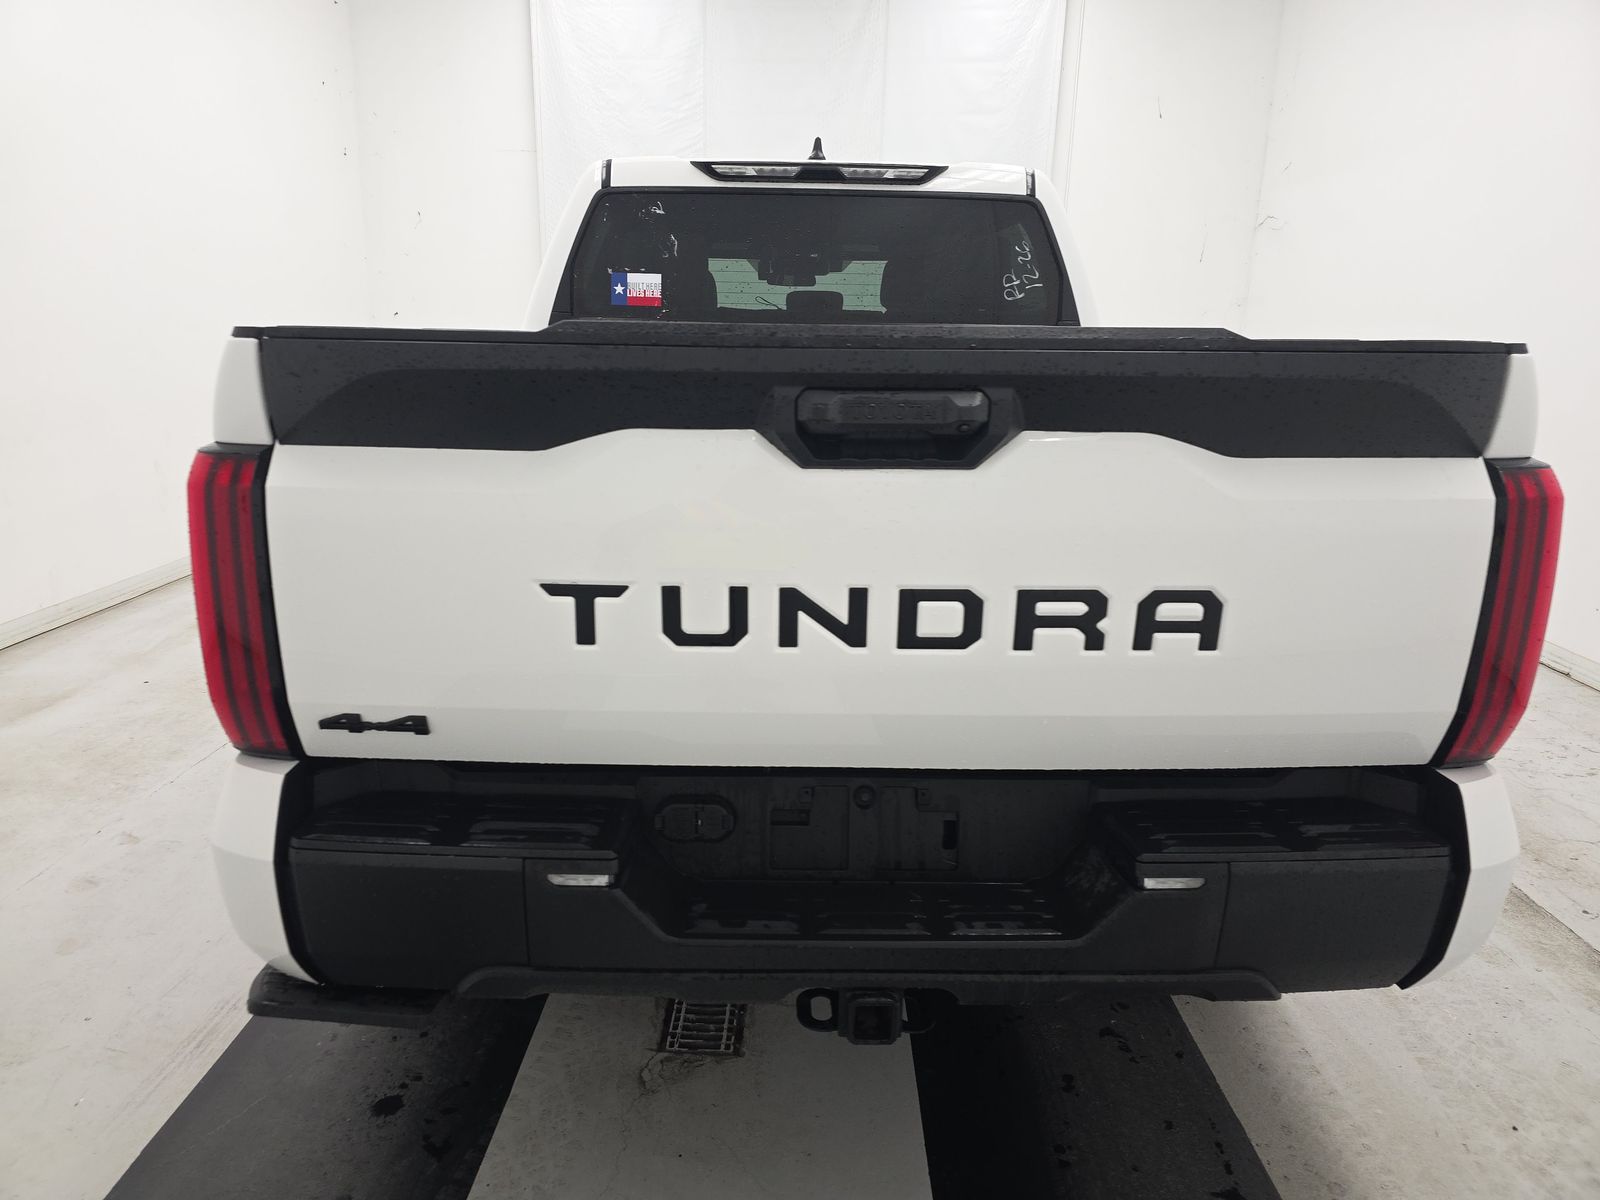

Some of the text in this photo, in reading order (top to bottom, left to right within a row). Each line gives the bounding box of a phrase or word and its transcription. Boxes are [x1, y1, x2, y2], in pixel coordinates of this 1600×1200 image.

[1015, 240, 1044, 289] 12-26
[627, 282, 662, 290] BUILT HERE
[627, 289, 662, 298] LIVES HERE
[847, 402, 937, 420] TOYOTA
[539, 583, 1224, 651] TUNDRA
